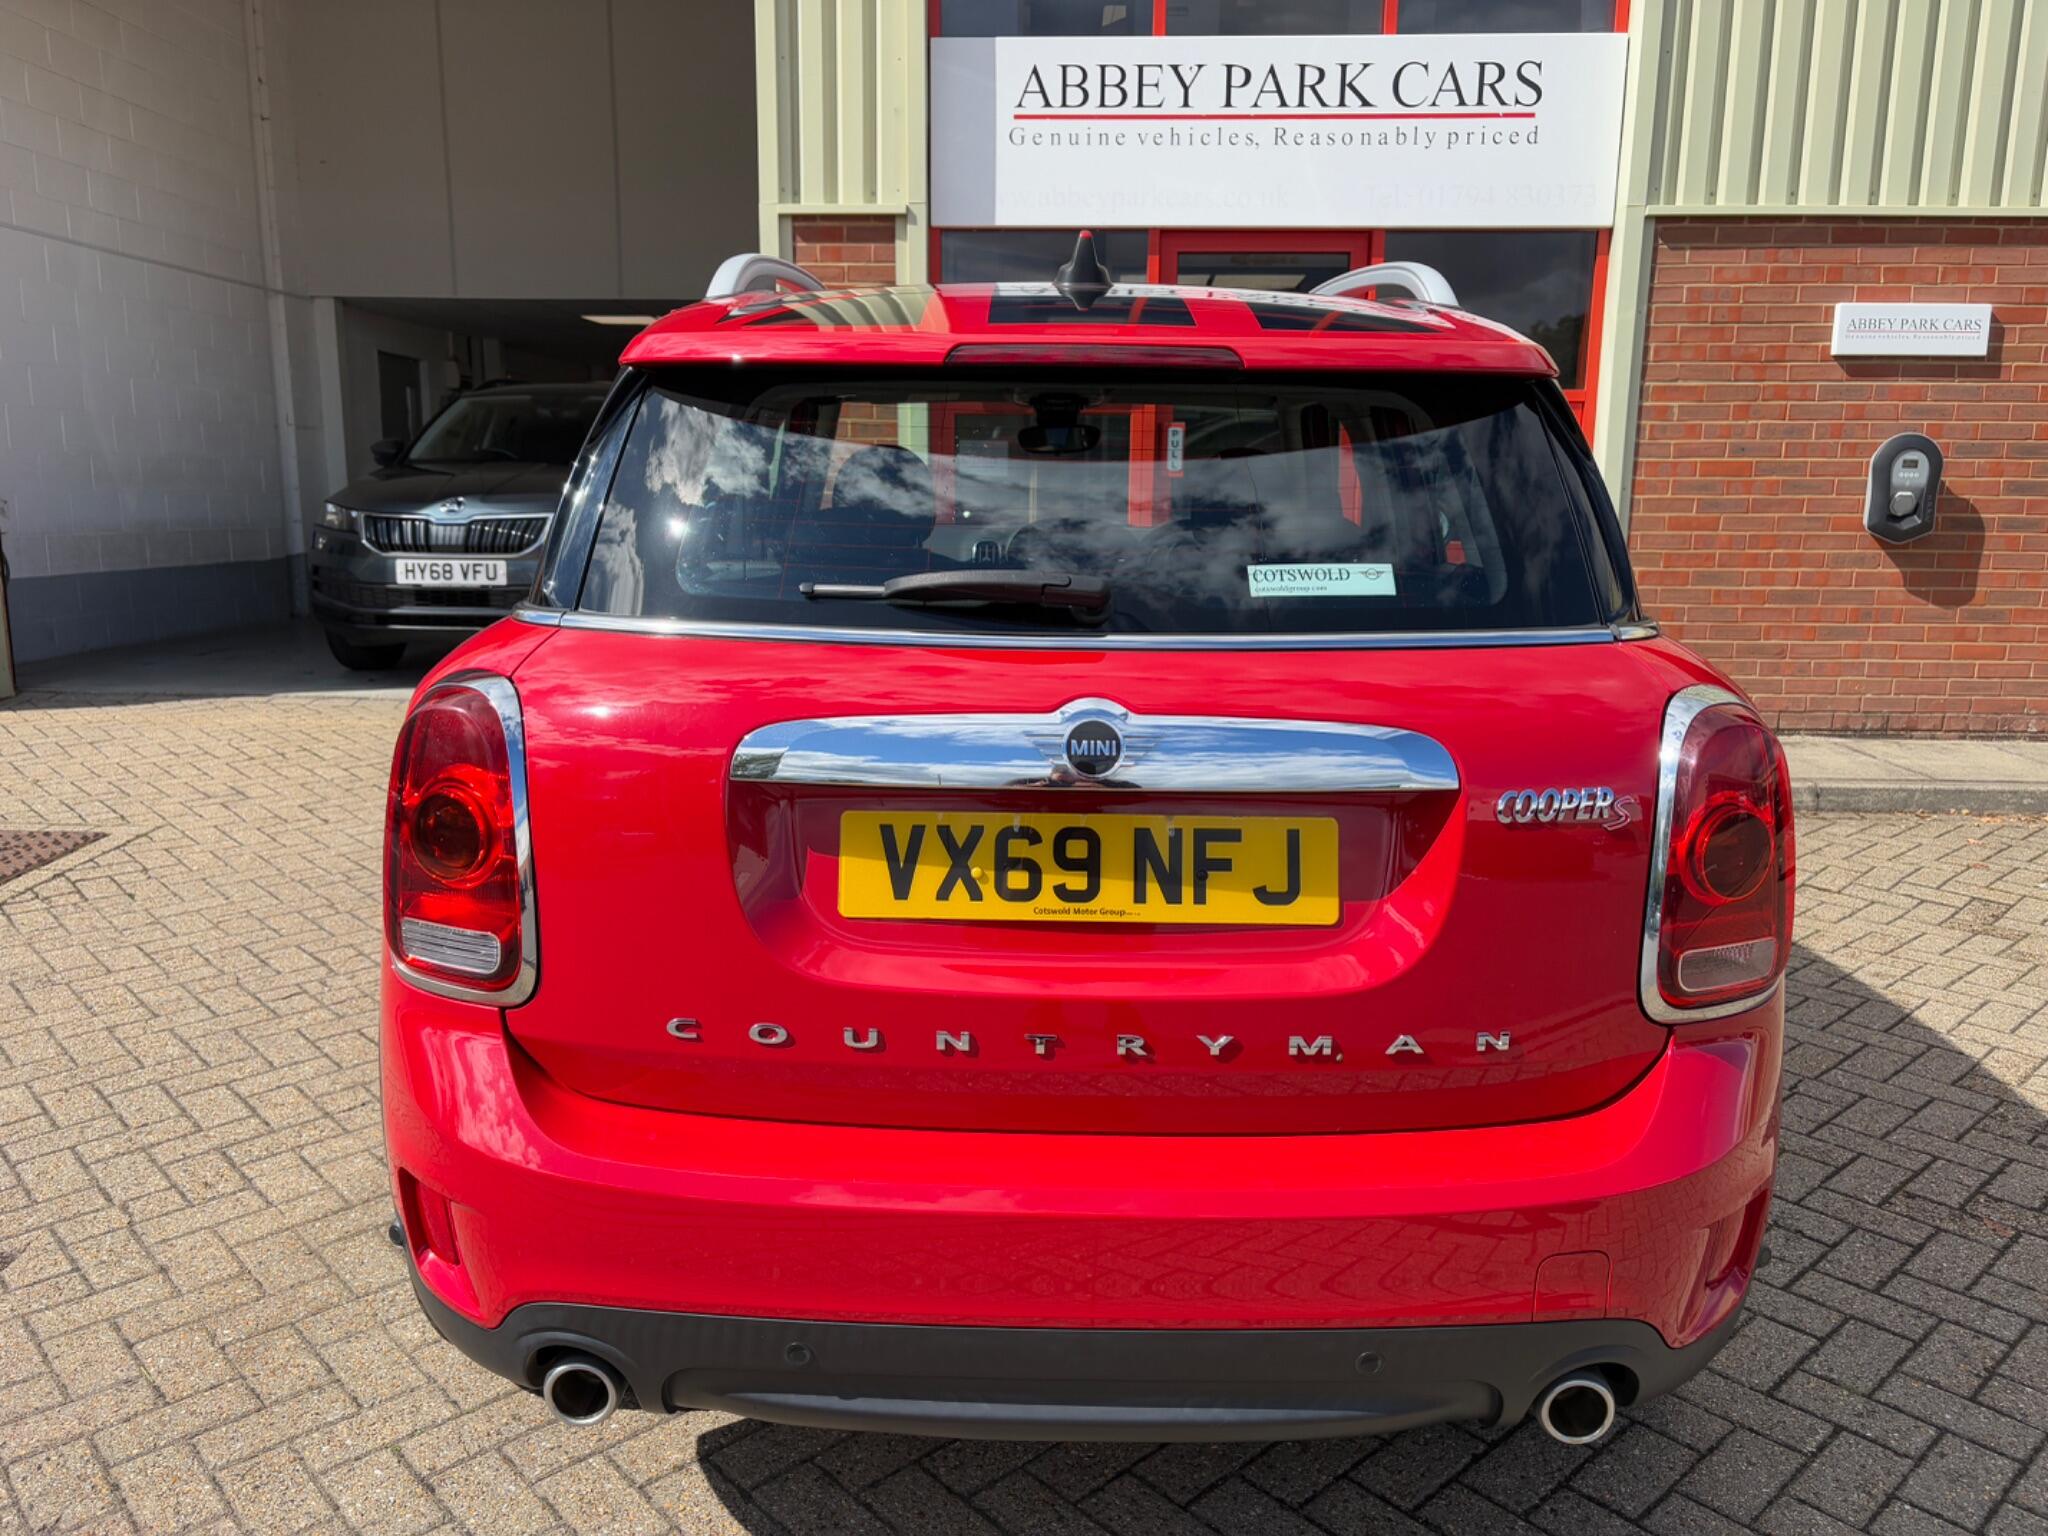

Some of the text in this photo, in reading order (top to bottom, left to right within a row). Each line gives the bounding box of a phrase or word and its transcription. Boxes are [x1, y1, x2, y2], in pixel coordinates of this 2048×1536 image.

[1014, 60, 1543, 108] ABBEY PARK CARS
[1009, 125, 1539, 149] Genuine vehicles, Reasonably priced
[1847, 318, 1982, 331] ABBEY PARK CARS
[1170, 429, 1180, 469] PULL
[404, 563, 498, 581] HY68 VFU
[1253, 567, 1350, 582] COTSWOLD
[1071, 739, 1116, 756] MINI
[879, 823, 1301, 906] VX69 NFJ
[1033, 906, 1071, 916] Cotswold
[1073, 907, 1098, 916] Motor
[1100, 907, 1126, 917] Group
[666, 1017, 1511, 1057] COUNTRYMAN
